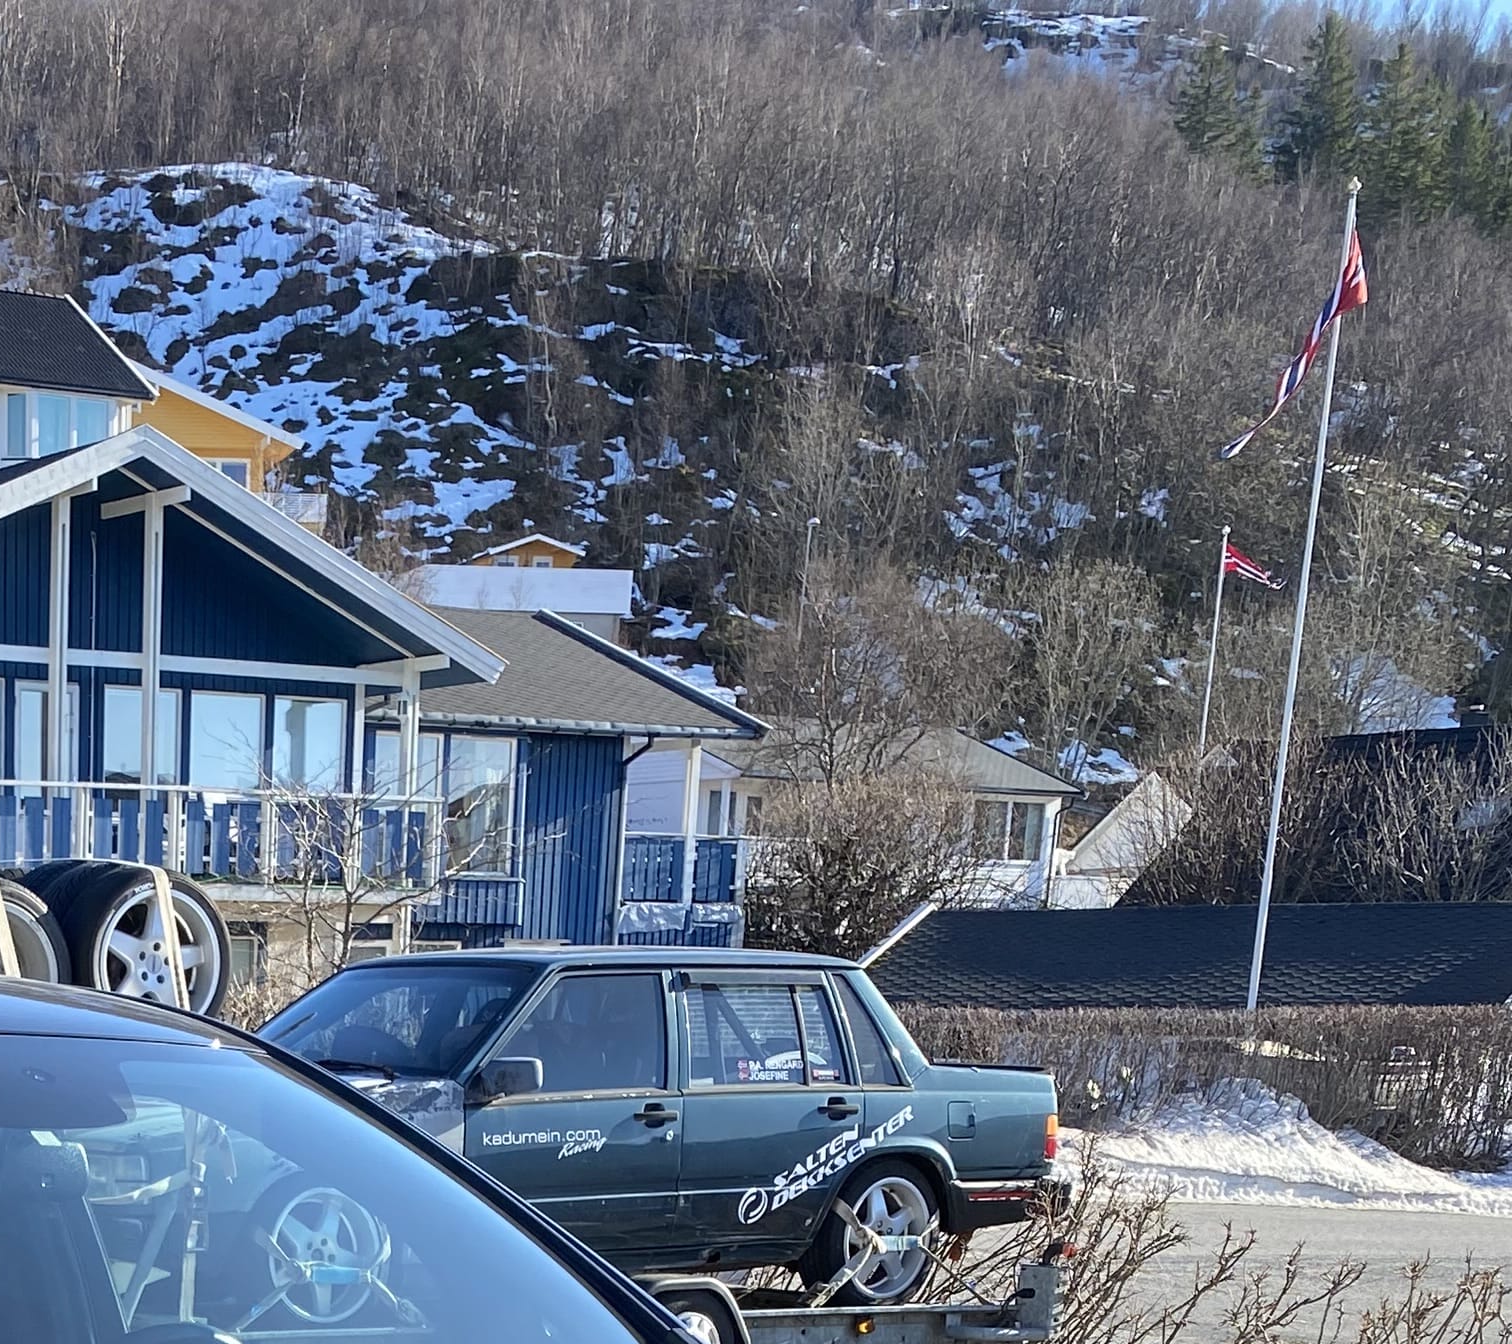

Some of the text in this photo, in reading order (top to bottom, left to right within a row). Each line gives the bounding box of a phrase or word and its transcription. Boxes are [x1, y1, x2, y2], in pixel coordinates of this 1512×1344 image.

[557, 1136, 607, 1160] Racing
[771, 1105, 915, 1211] DEKKSENTER
[773, 1123, 860, 1191] SALTEN
